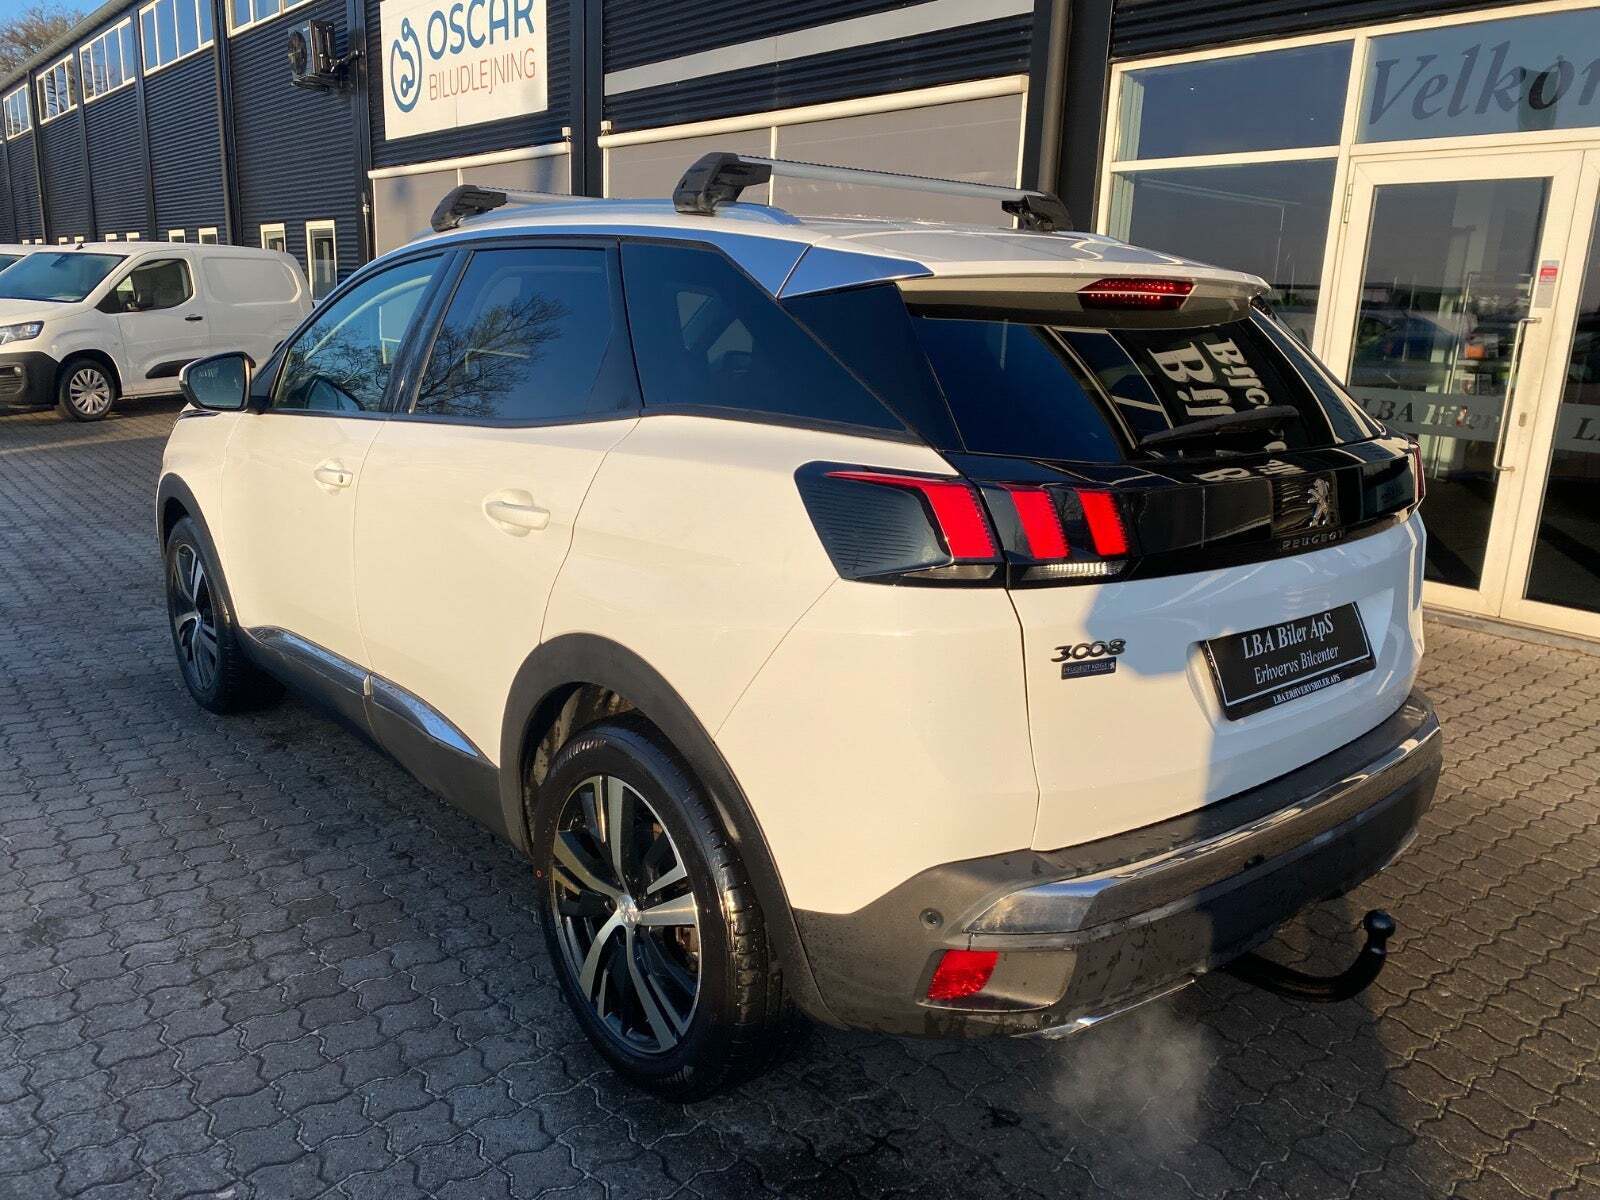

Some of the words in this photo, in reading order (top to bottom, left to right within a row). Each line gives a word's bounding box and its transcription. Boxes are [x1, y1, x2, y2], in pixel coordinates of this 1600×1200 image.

[427, 0, 534, 60] OSCAR
[429, 48, 536, 101] BILUDLEJNING
[1051, 638, 1126, 662] 3008
[1241, 630, 1275, 659] LBA
[1277, 623, 1307, 648] Biler
[1310, 612, 1334, 642] ApS
[1254, 661, 1299, 685] Erhvervs
[1300, 646, 1339, 670] Bilcenter
